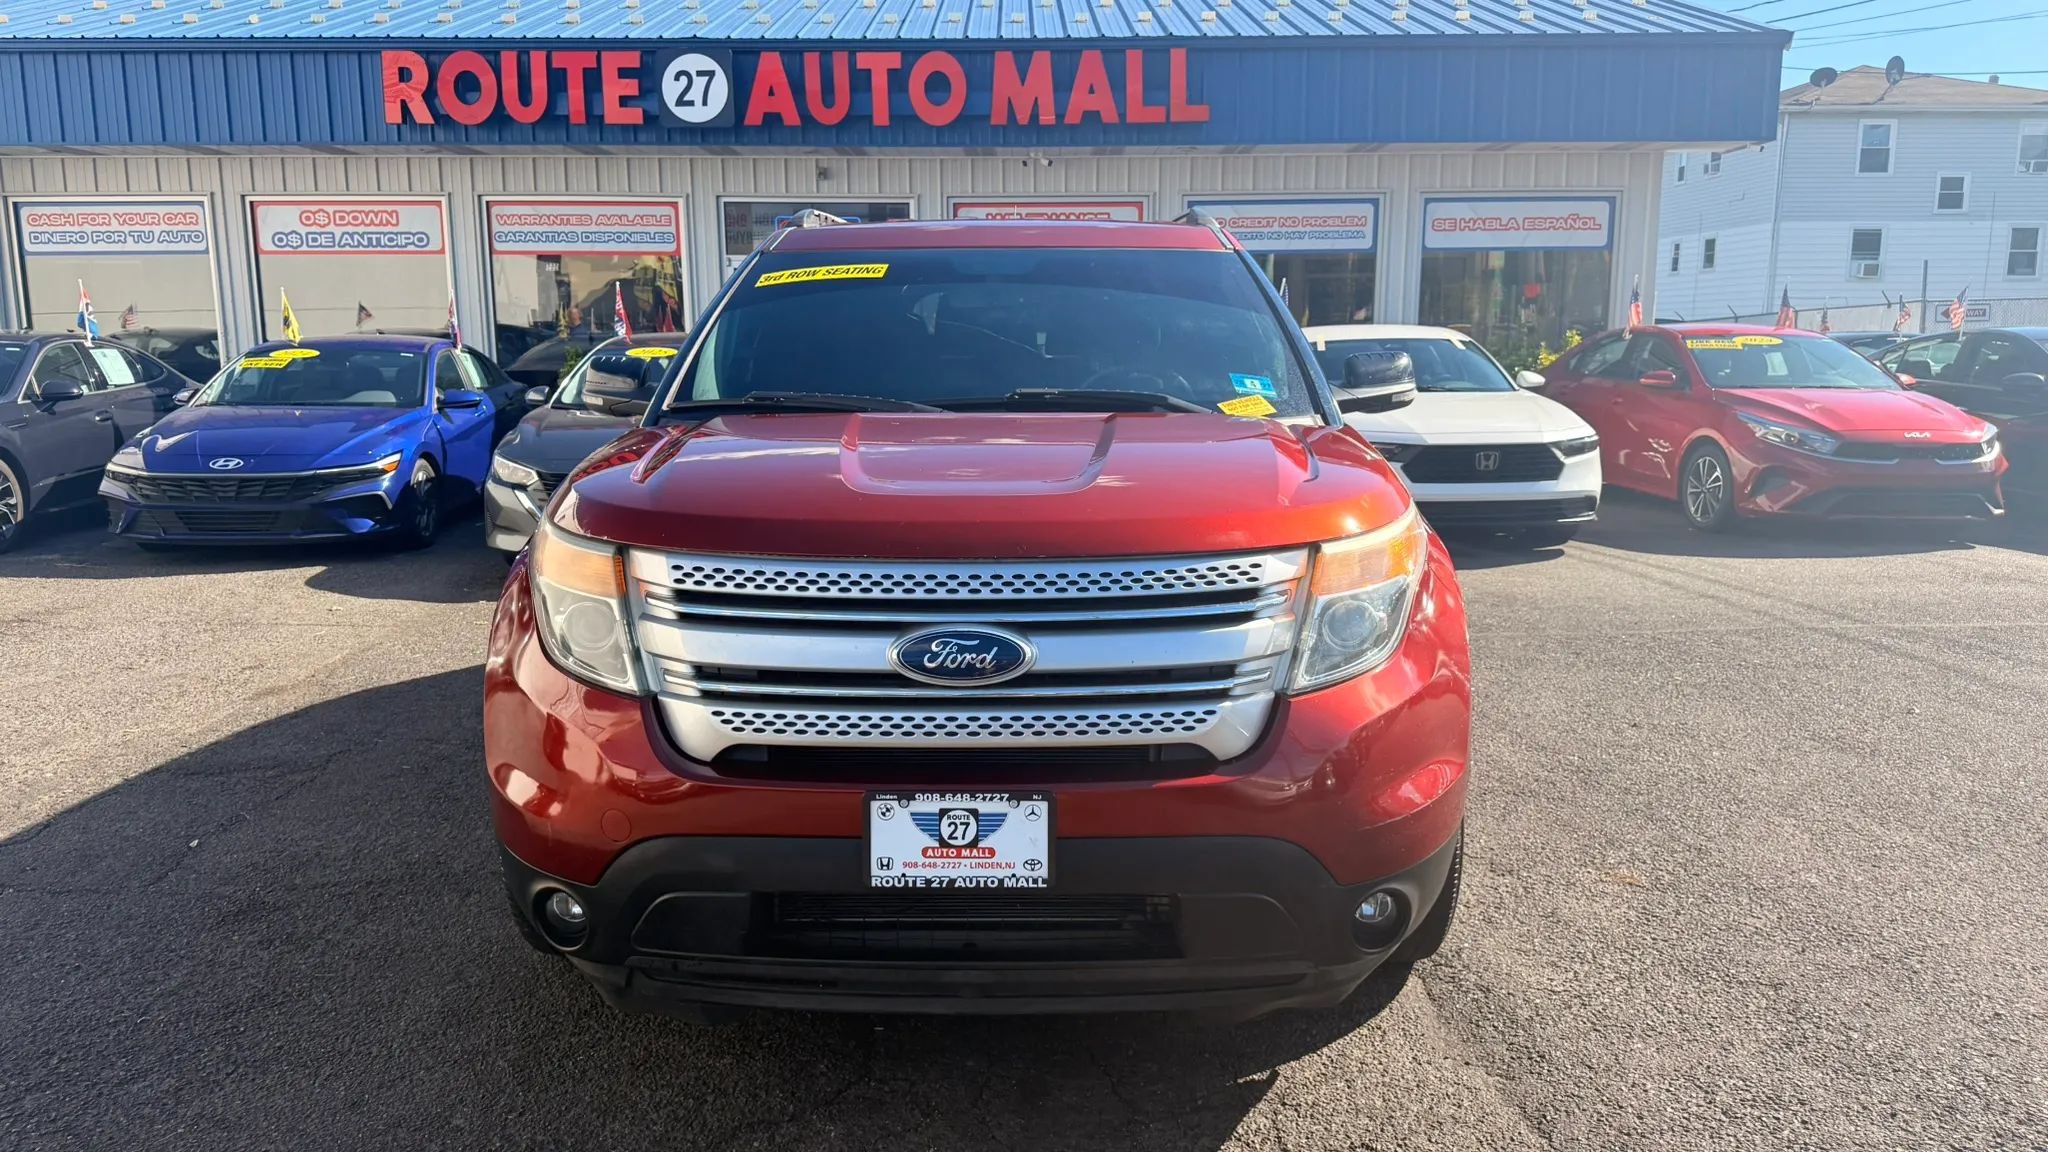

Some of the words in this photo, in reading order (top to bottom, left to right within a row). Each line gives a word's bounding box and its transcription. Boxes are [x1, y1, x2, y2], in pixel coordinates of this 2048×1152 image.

[380, 49, 645, 126] ROUTE
[673, 69, 716, 108] 27
[743, 50, 968, 126] AUTO
[990, 47, 1210, 126] MALL
[27, 212, 74, 226] CASH
[77, 213, 112, 226] FOR
[114, 212, 160, 226] YOUR
[162, 212, 198, 226] CAR
[333, 210, 399, 227] DOWN
[496, 214, 592, 227] WARRANTIES
[594, 214, 672, 227] AVAILABLE
[1228, 216, 1277, 229] CREDIT
[1278, 217, 1300, 228] NO
[1301, 216, 1367, 228] PROBLEM
[1432, 217, 1458, 232] SE
[1459, 217, 1520, 231] HABLA
[1522, 213, 1602, 231] ESPAÑOL
[29, 230, 89, 245] DINERO
[91, 230, 127, 245] POR
[129, 230, 154, 244] TU
[158, 230, 204, 244] AUTO
[305, 231, 336, 249] DE
[338, 231, 430, 249] ANTICIPO
[495, 231, 579, 243] GARANTIAS
[580, 231, 675, 244] DISPONIBLES
[1266, 231, 1284, 241] NO
[1284, 231, 1307, 240] HAY
[1307, 230, 1366, 240] PROBLEMA
[759, 273, 783, 284] 3rd
[784, 269, 821, 281] ROW
[822, 265, 884, 276] SEATING
[1966, 309, 1985, 317] WAY
[923, 638, 998, 669] Ford
[915, 793, 1009, 803] 908-648-2727
[947, 821, 971, 841] 27
[926, 848, 957, 858] AUTO
[961, 848, 992, 858] MALL
[902, 861, 962, 869] 908-648-2727
[871, 876, 926, 888] ROUTE
[930, 876, 950, 888] 27
[954, 876, 999, 888] AUTO
[1003, 876, 1048, 888] MALL
